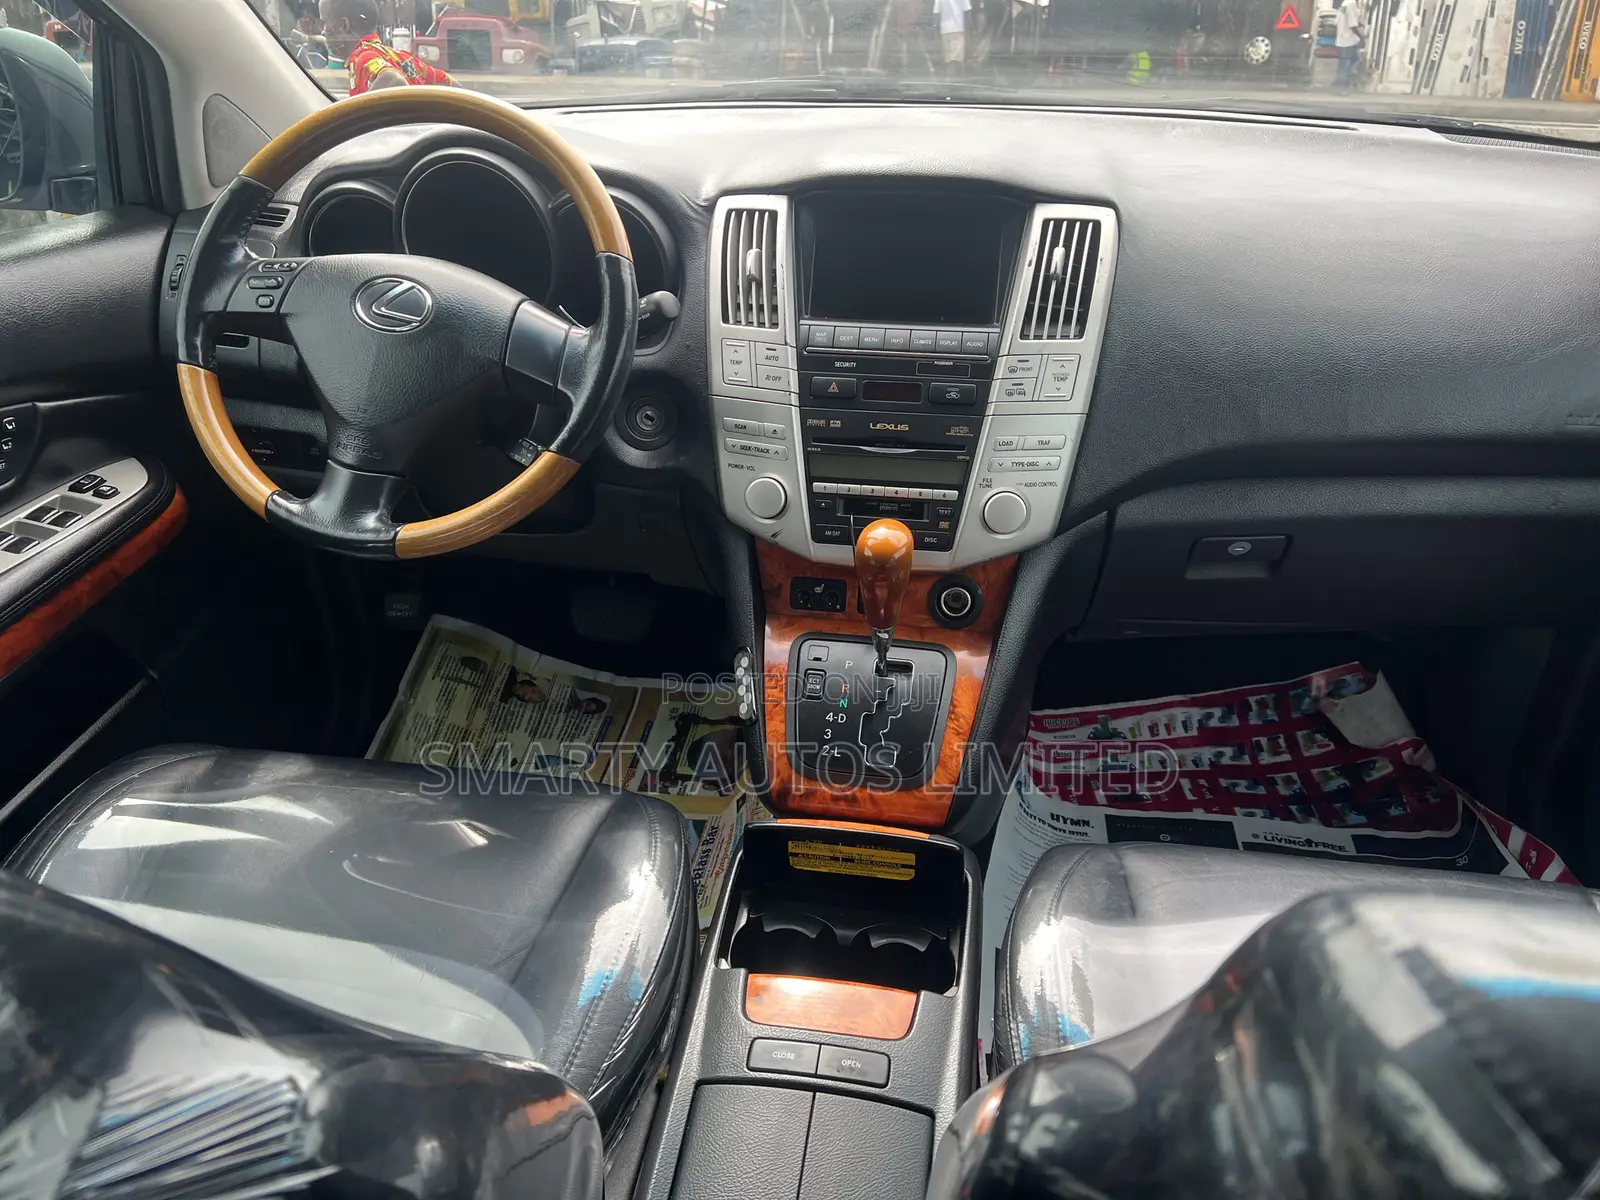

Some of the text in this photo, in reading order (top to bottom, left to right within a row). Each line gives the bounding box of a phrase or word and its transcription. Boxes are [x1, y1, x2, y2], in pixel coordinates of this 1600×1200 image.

[1514, 20, 1527, 55] IVECO
[1579, 20, 1591, 50] IVECO
[1431, 33, 1445, 61] IVECO
[869, 422, 910, 431] LEXUS
[845, 660, 853, 669] P
[841, 683, 850, 694] R
[839, 699, 848, 708] N
[825, 711, 847, 723] 4-D
[823, 728, 832, 739] 3
[821, 745, 842, 757] 2-L
[1263, 835, 1347, 852] LIVING FREE
[1456, 855, 1468, 867] 30
[772, 1051, 795, 1060] CLOSE
[841, 1059, 862, 1069] OPEN
